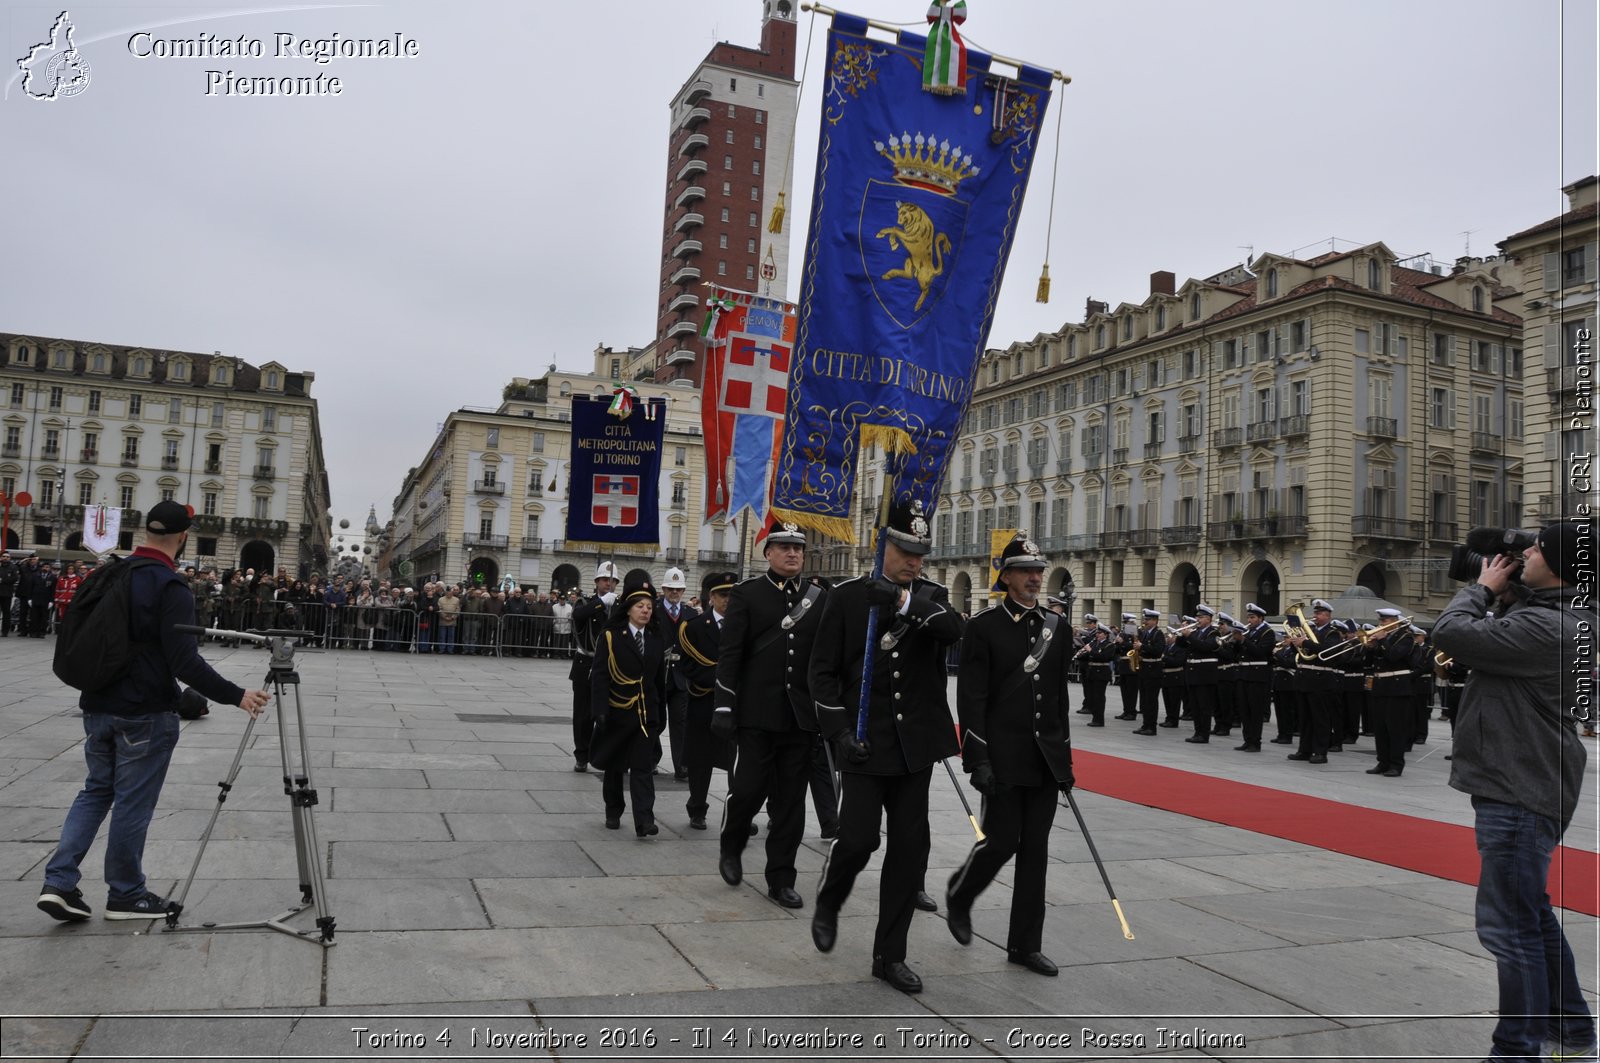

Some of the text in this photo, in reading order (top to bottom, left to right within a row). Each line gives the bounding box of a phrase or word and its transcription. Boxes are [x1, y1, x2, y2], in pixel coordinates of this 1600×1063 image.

[812, 348, 964, 403] CITTA' DI TORINO
[605, 424, 632, 437] CITTÀ
[578, 438, 656, 451] METROPOLITANA
[593, 453, 641, 465] DI TORINO
